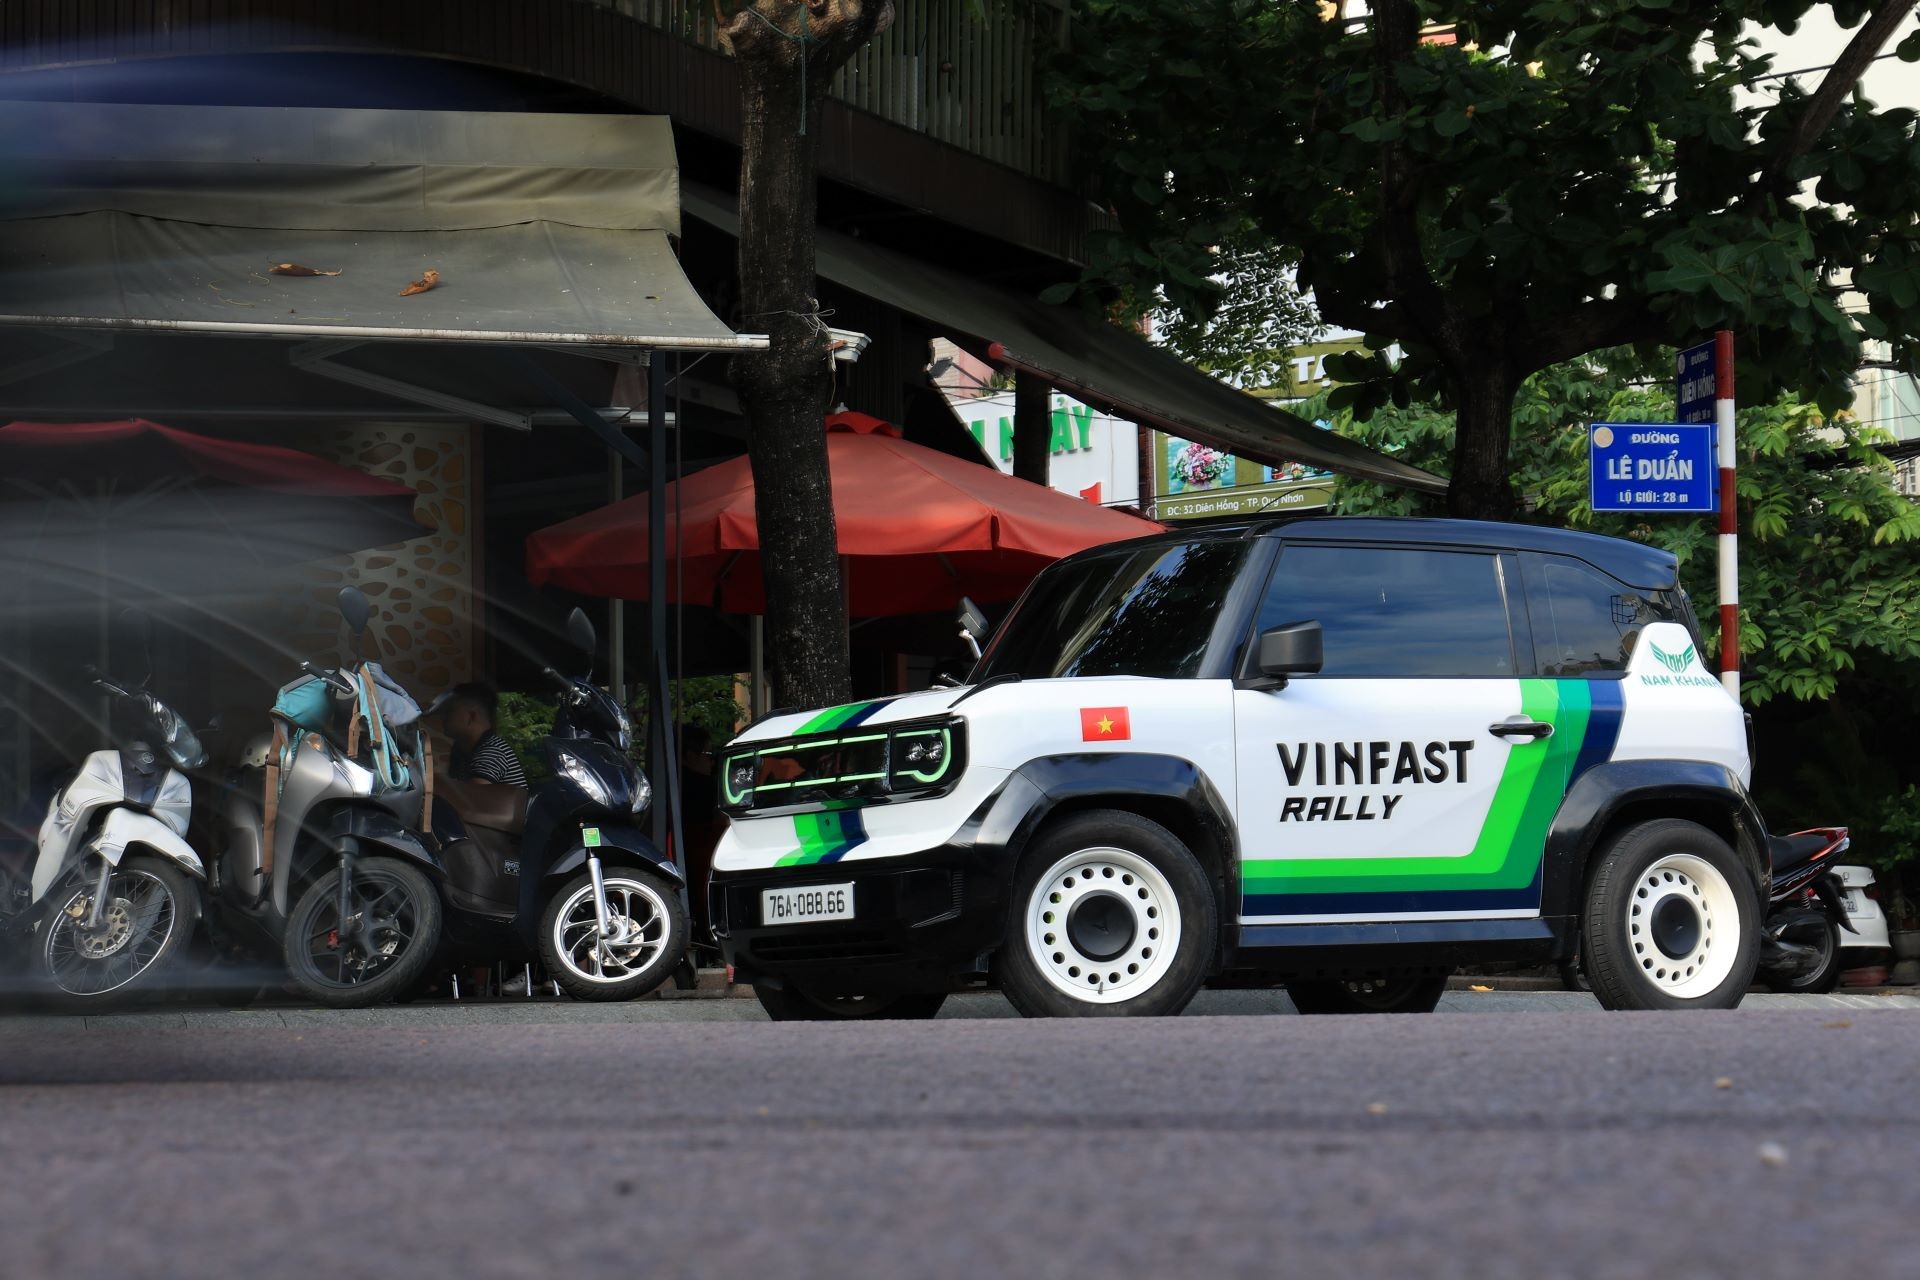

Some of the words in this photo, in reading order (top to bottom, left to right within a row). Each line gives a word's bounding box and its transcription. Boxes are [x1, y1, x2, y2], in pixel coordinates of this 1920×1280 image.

[1631, 431, 1680, 444] ĐƯỜNG
[1608, 455, 1633, 480] LÊ
[1638, 450, 1693, 480] DUẨN
[1167, 505, 1182, 516] ĐC:
[1184, 503, 1194, 515] 32
[1196, 502, 1214, 513] Diên
[1247, 498, 1260, 508] TP.
[1261, 496, 1279, 508] Quy
[1281, 494, 1304, 504] Nhơn
[1619, 490, 1632, 504] LỘ
[1635, 490, 1660, 503] GIỚI:
[1663, 492, 1676, 503] 28
[1679, 494, 1689, 503] m
[1641, 674, 1674, 687] NAM
[1276, 739, 1475, 786] VINFAST
[1279, 794, 1403, 822] RALLY
[769, 890, 845, 918] 76A-088.66
